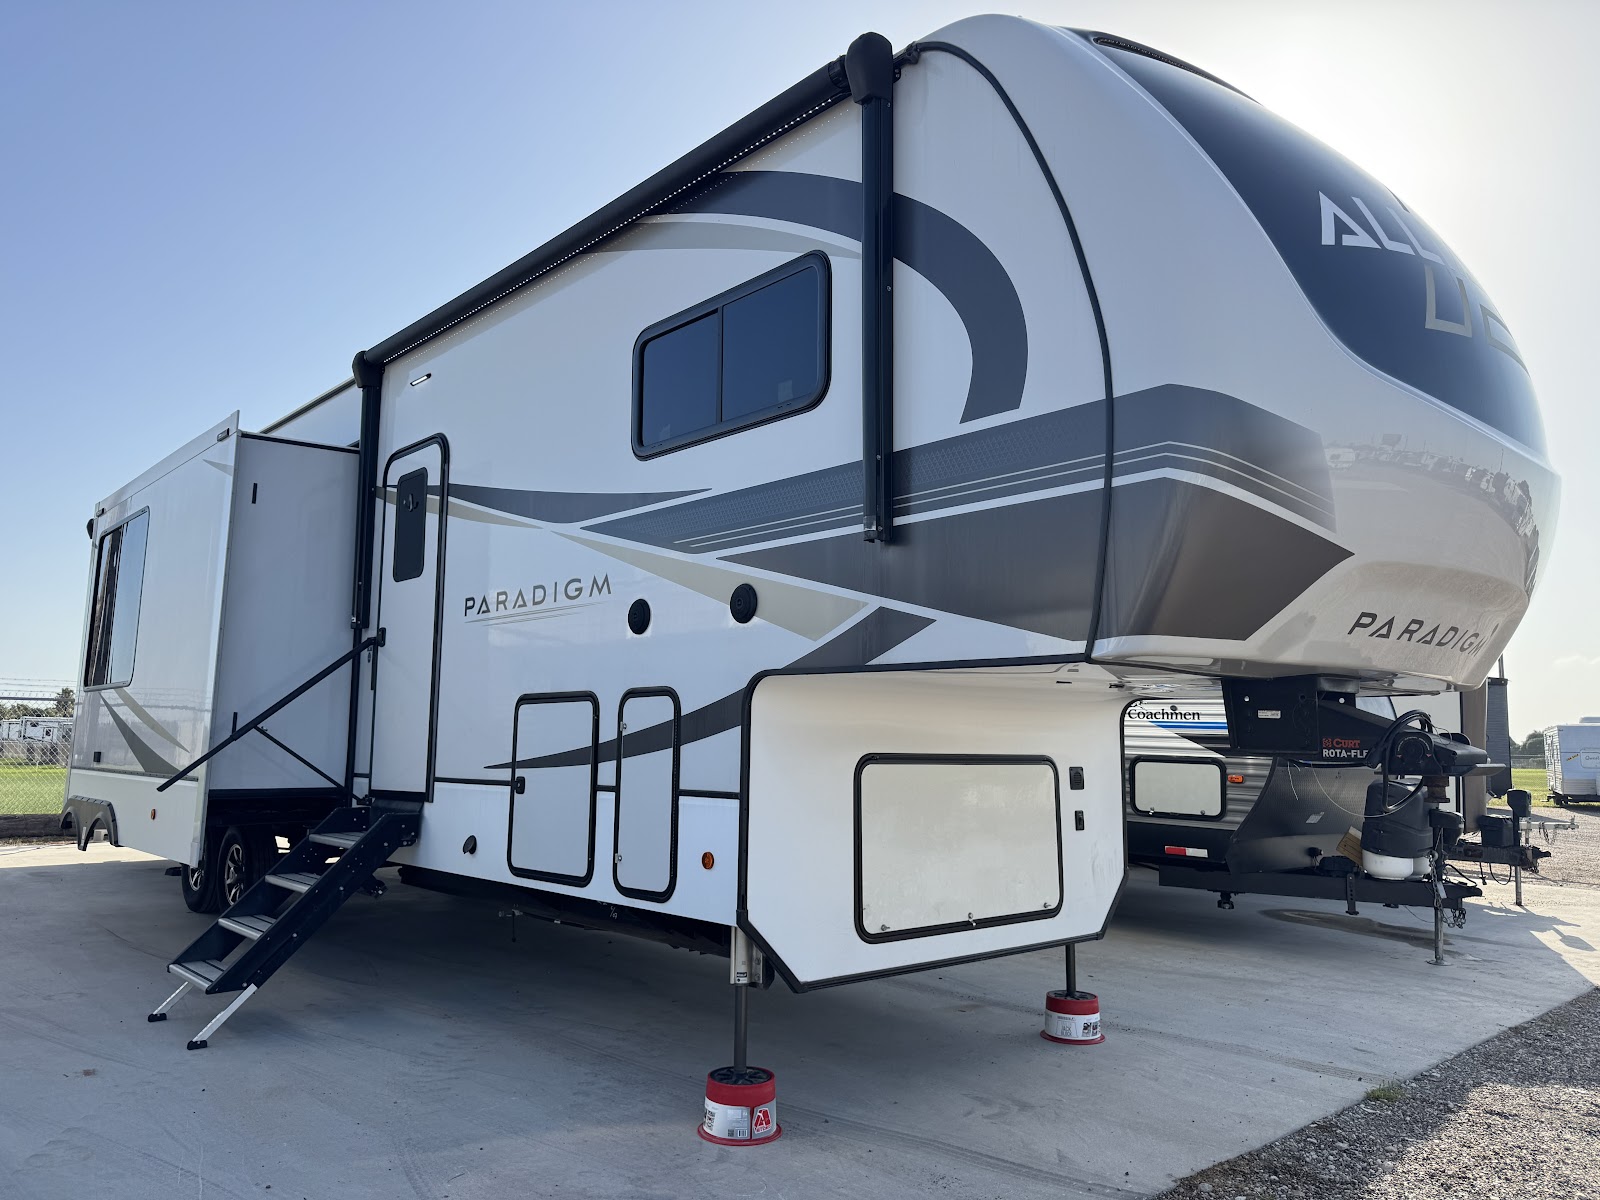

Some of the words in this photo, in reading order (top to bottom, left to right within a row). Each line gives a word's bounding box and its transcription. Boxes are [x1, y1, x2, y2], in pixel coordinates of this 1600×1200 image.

[464, 572, 612, 617] PARADIGM
[1347, 611, 1488, 657] PARADIGM
[1127, 708, 1201, 721] Coachmen
